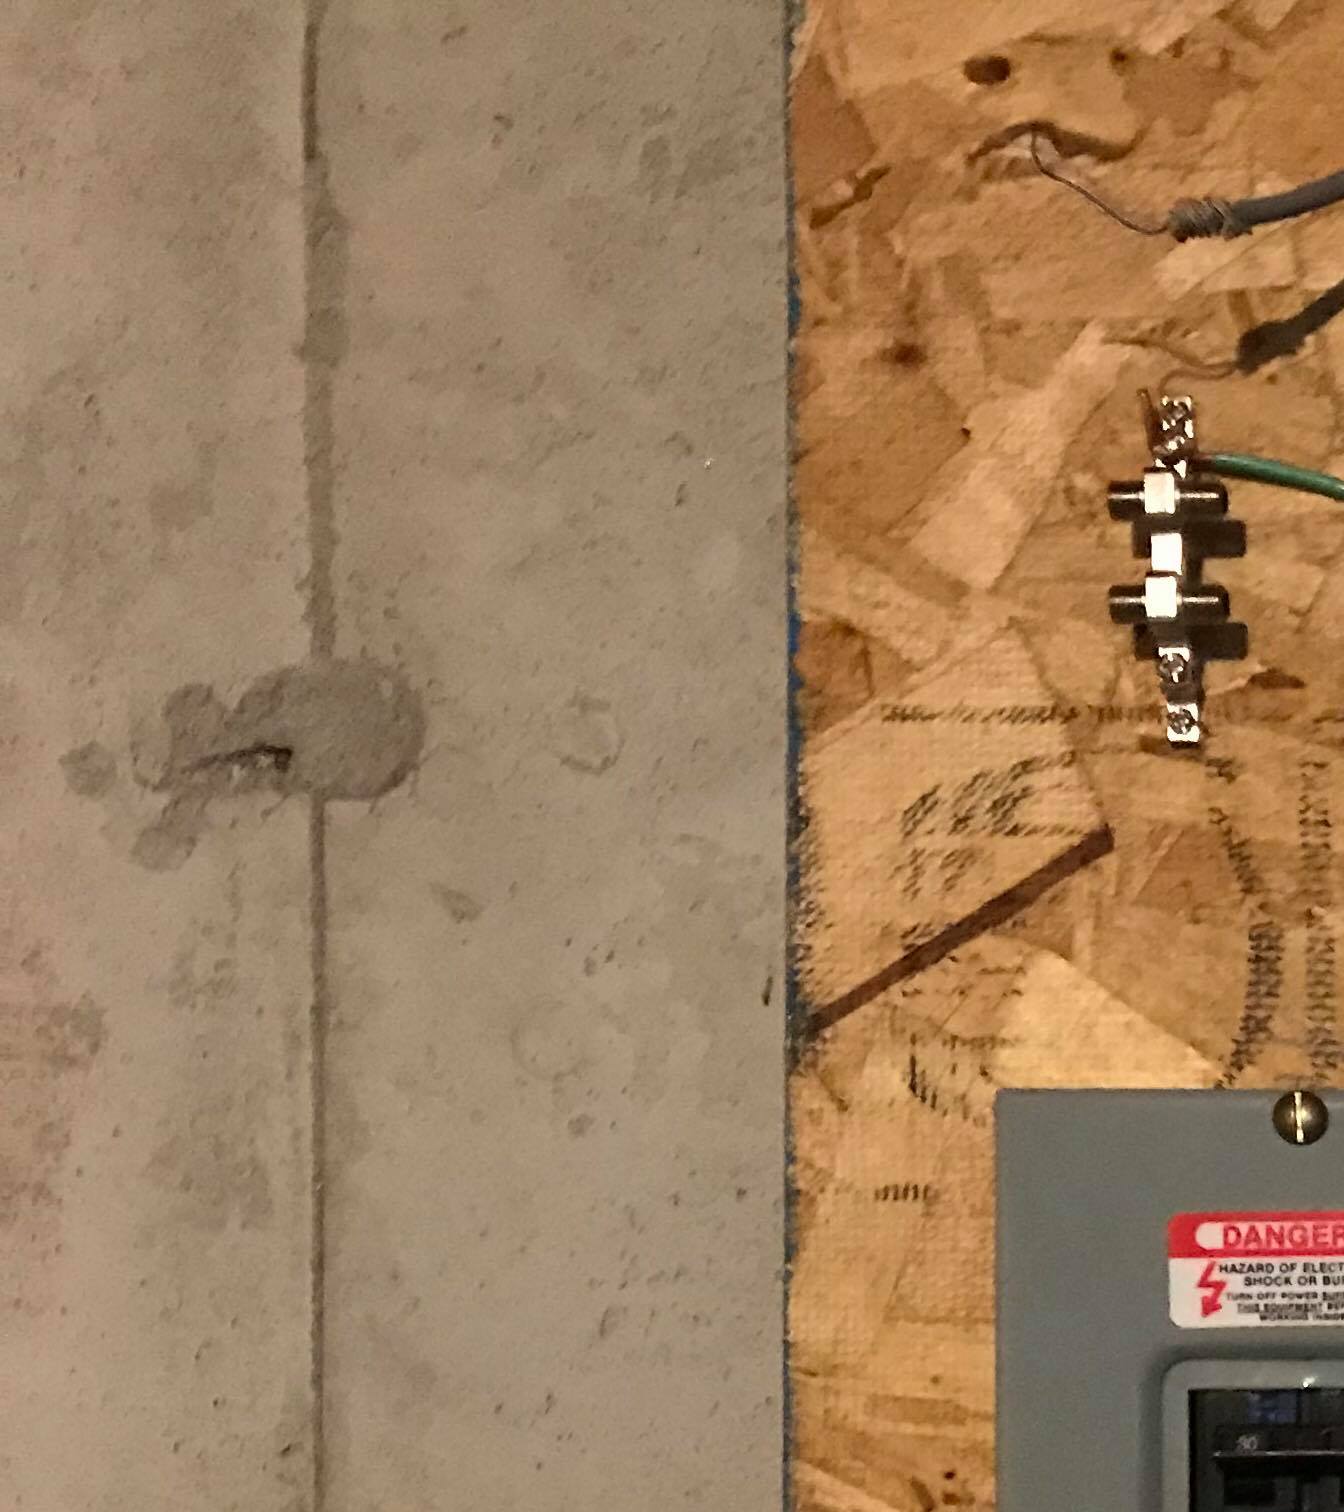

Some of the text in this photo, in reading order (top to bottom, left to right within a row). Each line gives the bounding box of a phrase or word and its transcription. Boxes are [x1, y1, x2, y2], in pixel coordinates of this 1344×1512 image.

[1219, 1262, 1274, 1274] HAZARD
[1279, 1262, 1297, 1274] OF
[1244, 1275, 1292, 1287] SHOCK
[1297, 1275, 1317, 1287] OR
[1226, 1292, 1252, 1300] TURN
[1257, 1292, 1276, 1300] OFF
[1281, 1292, 1318, 1300] POWER
